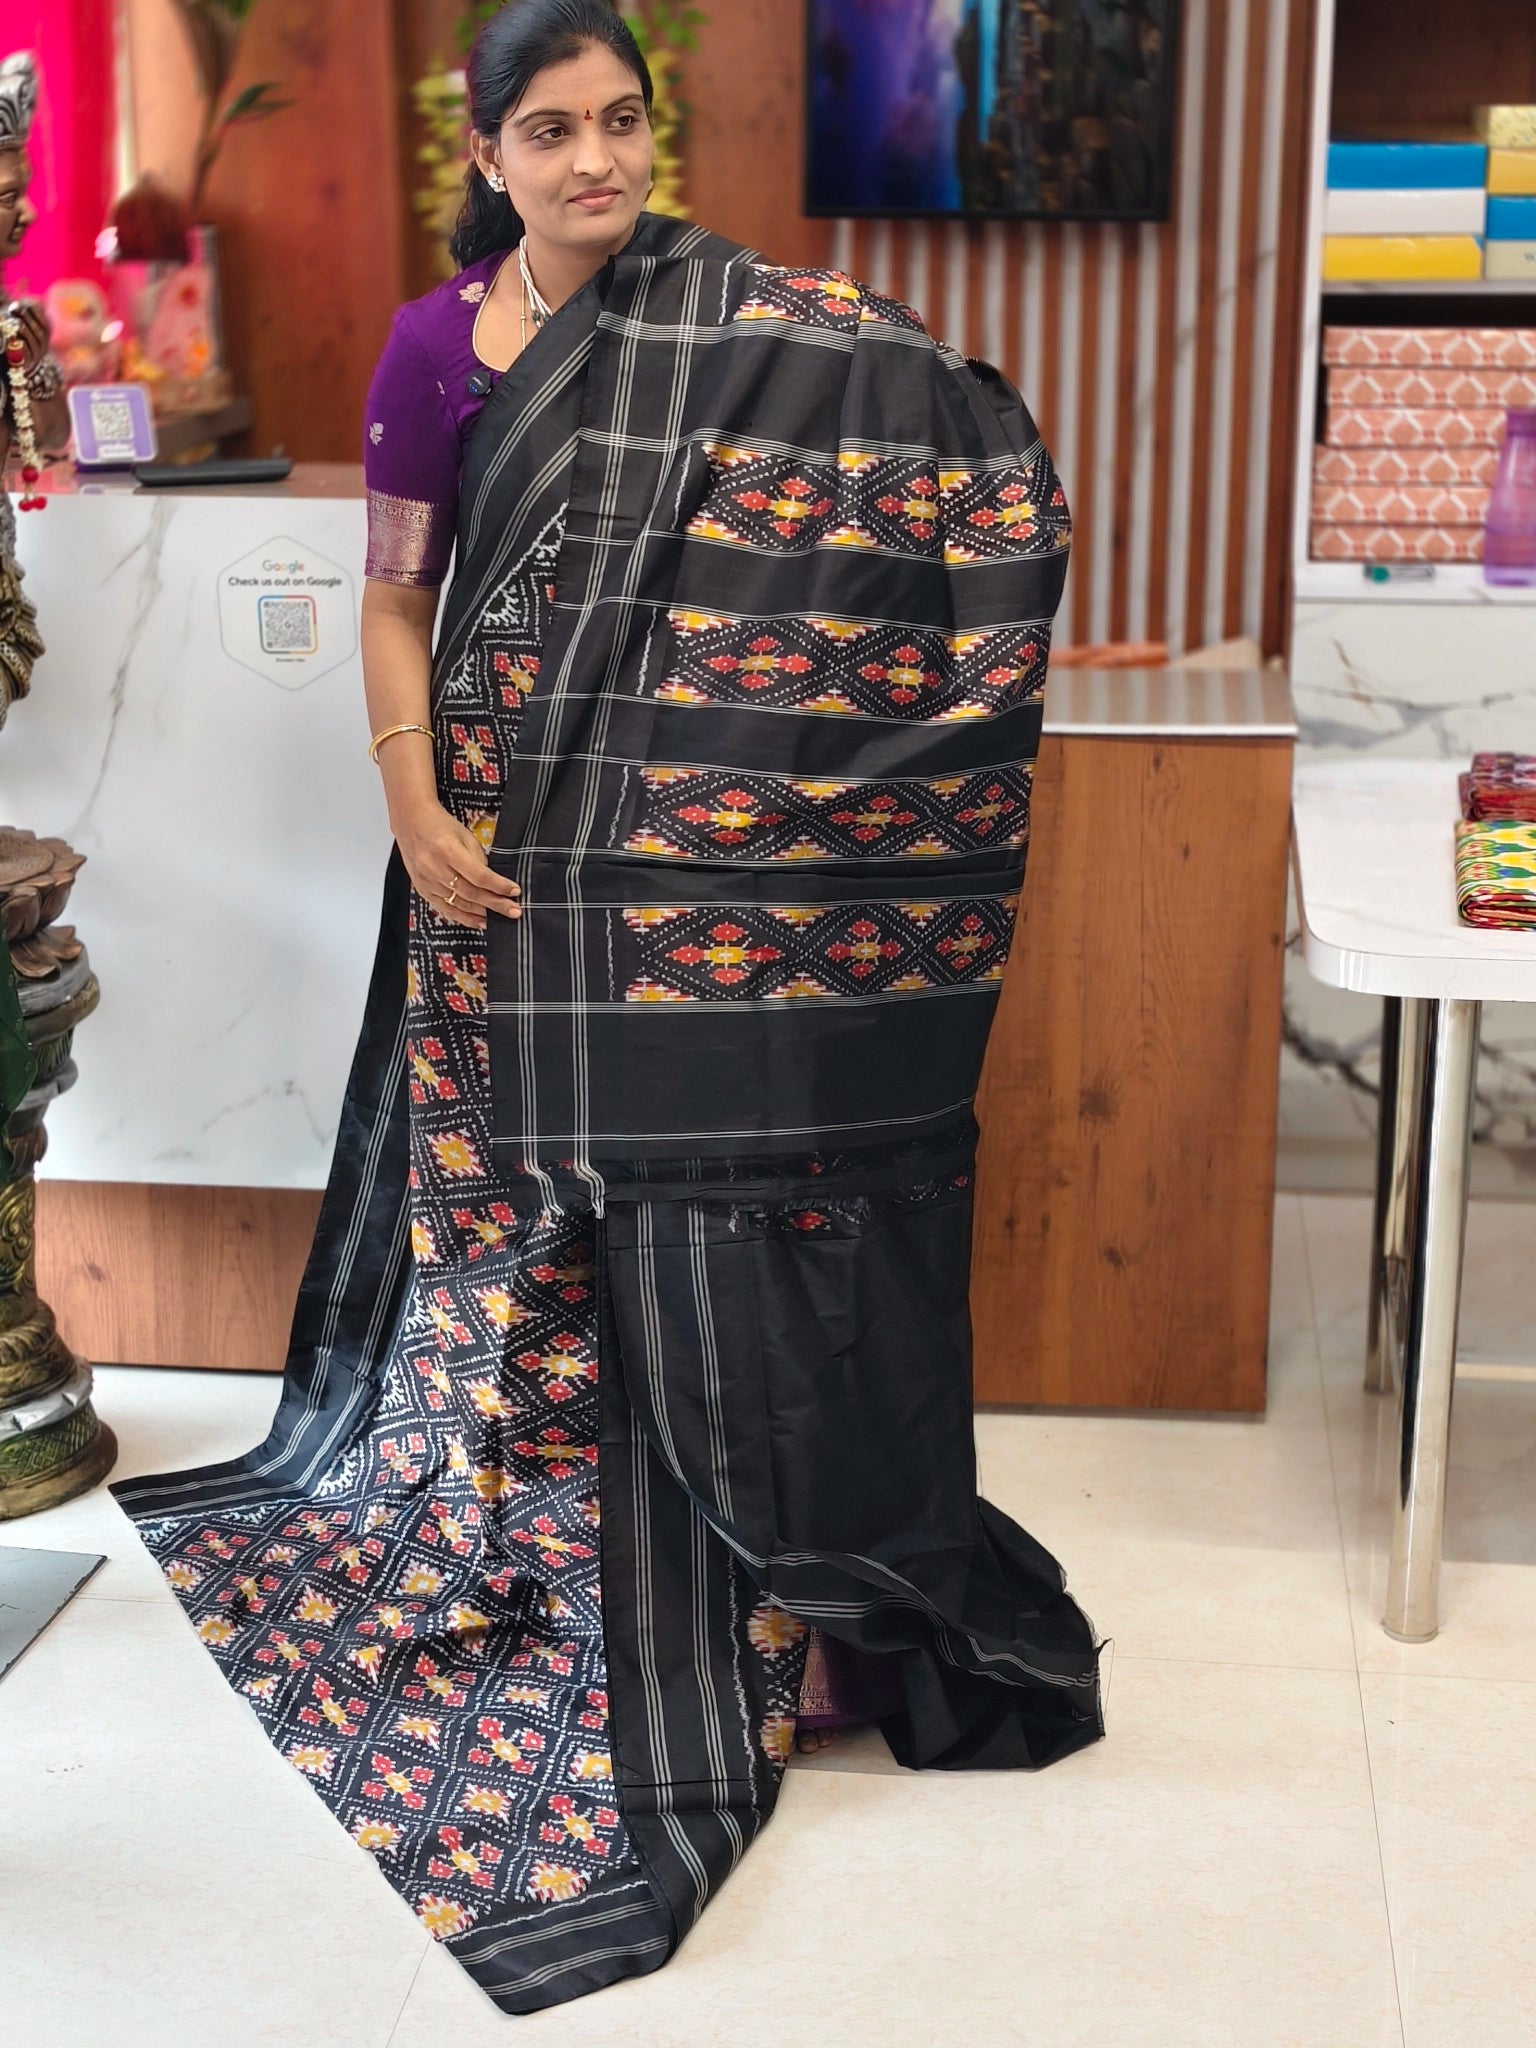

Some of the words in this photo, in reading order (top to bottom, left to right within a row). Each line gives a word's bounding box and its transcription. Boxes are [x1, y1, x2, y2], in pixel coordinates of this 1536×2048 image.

[262, 559, 305, 574] Google
[228, 576, 259, 586] Check
[274, 577, 290, 586] out
[292, 578, 305, 586] on
[306, 576, 342, 588] Google
